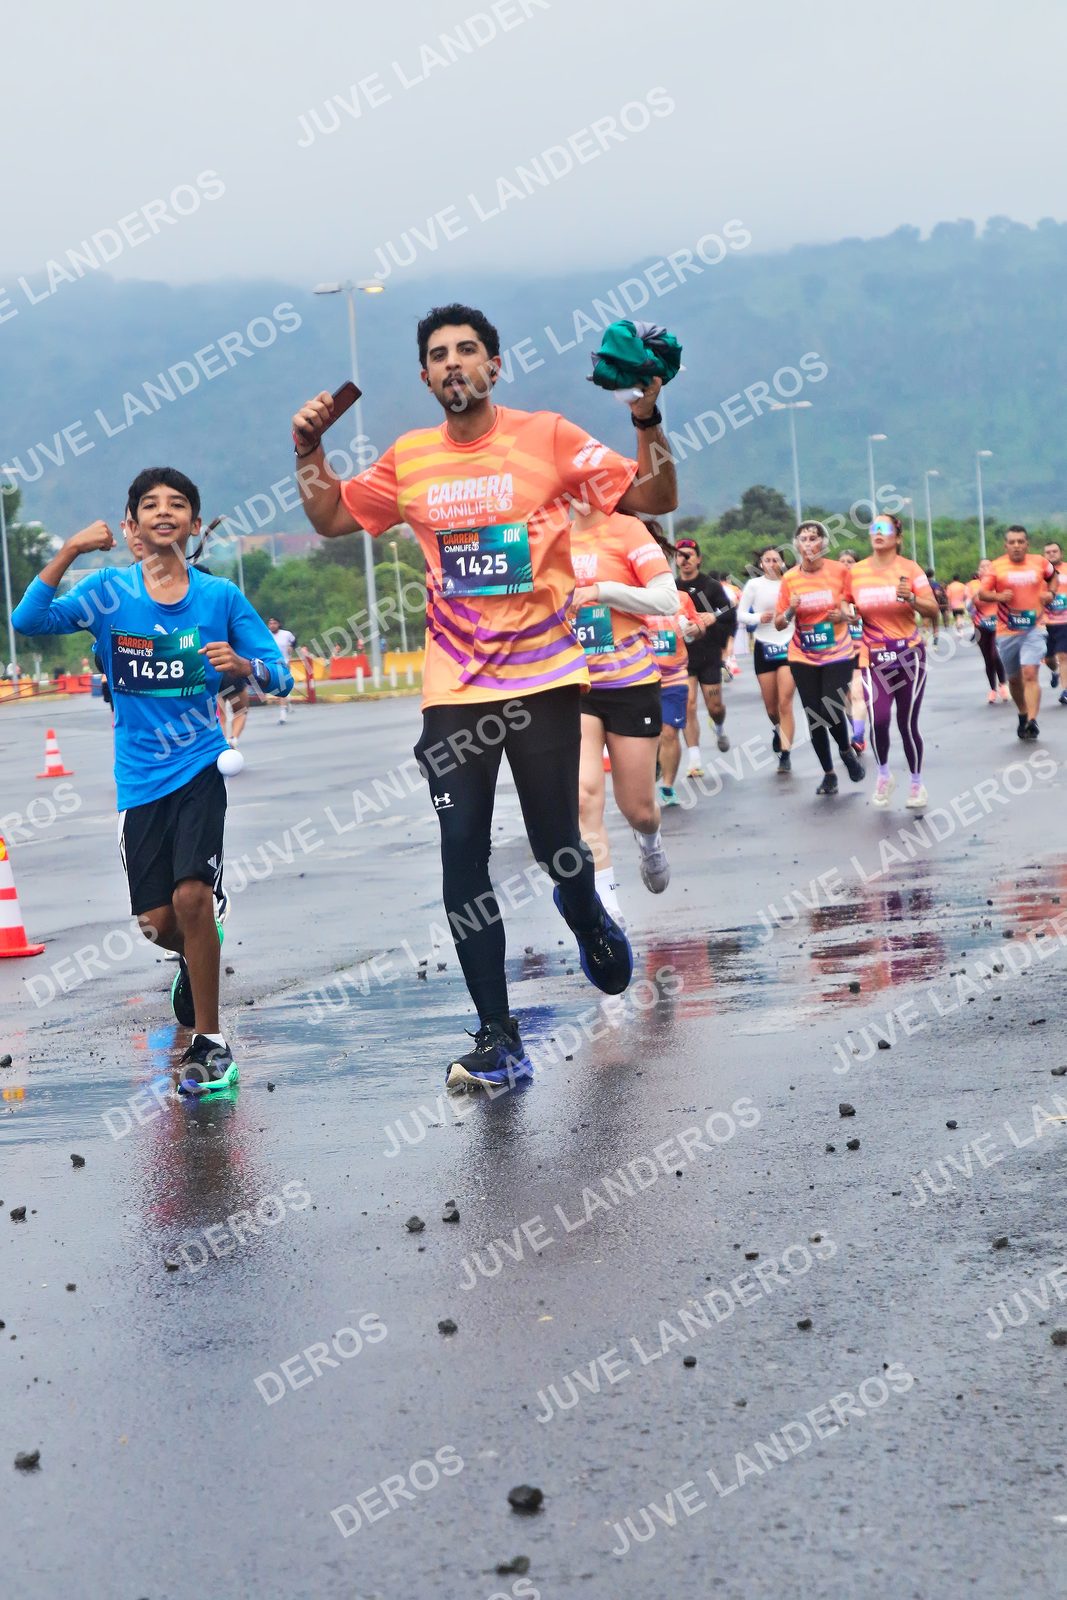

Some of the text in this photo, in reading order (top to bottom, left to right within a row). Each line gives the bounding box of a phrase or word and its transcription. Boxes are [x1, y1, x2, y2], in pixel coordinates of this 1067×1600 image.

[427, 473, 513, 505] CARRERA
[443, 528, 520, 545] CARRERA 10K
[456, 554, 508, 576] 1425
[573, 626, 595, 641] 61
[804, 633, 828, 644] 1156
[118, 634, 194, 650] CARRERA 10K
[877, 651, 897, 662] 458
[128, 660, 184, 679] 1428
